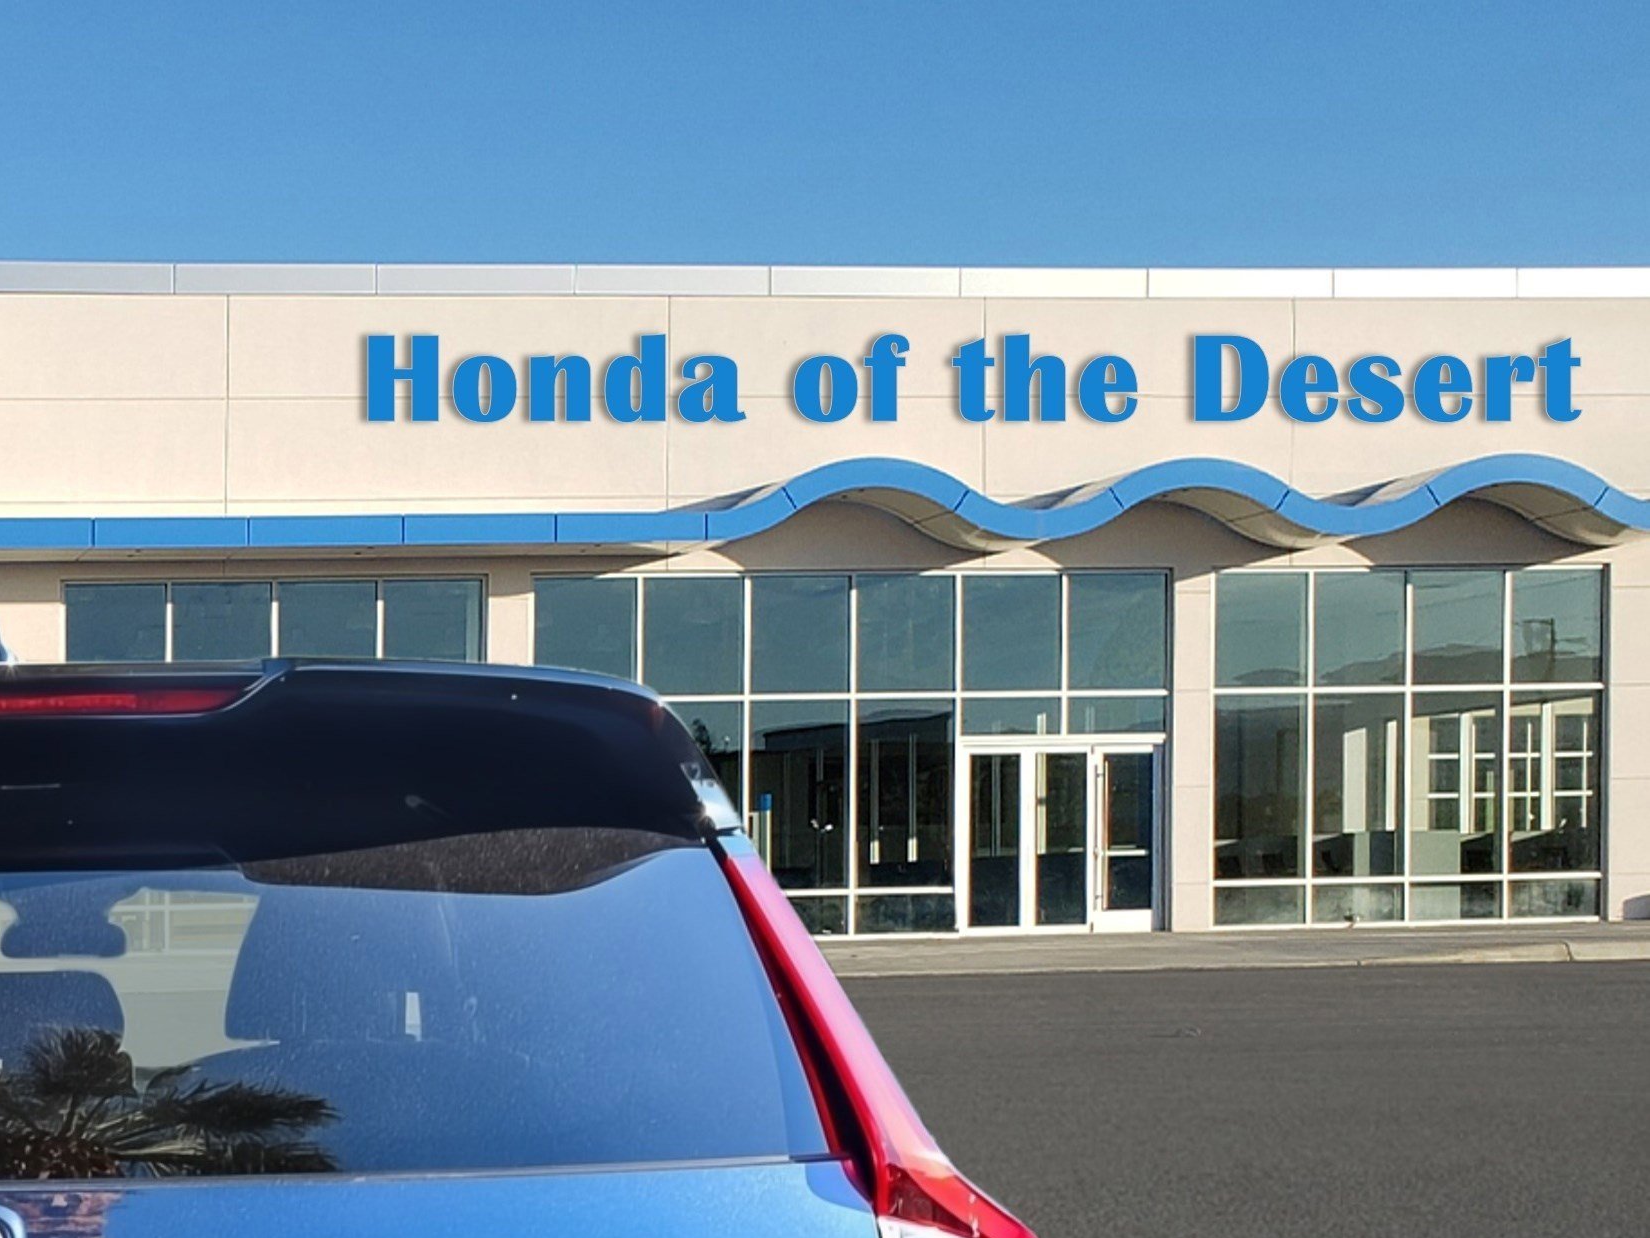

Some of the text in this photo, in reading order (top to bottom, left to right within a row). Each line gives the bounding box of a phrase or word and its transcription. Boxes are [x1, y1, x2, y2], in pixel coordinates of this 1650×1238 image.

[366, 333, 1582, 424] Honda of the Desert
